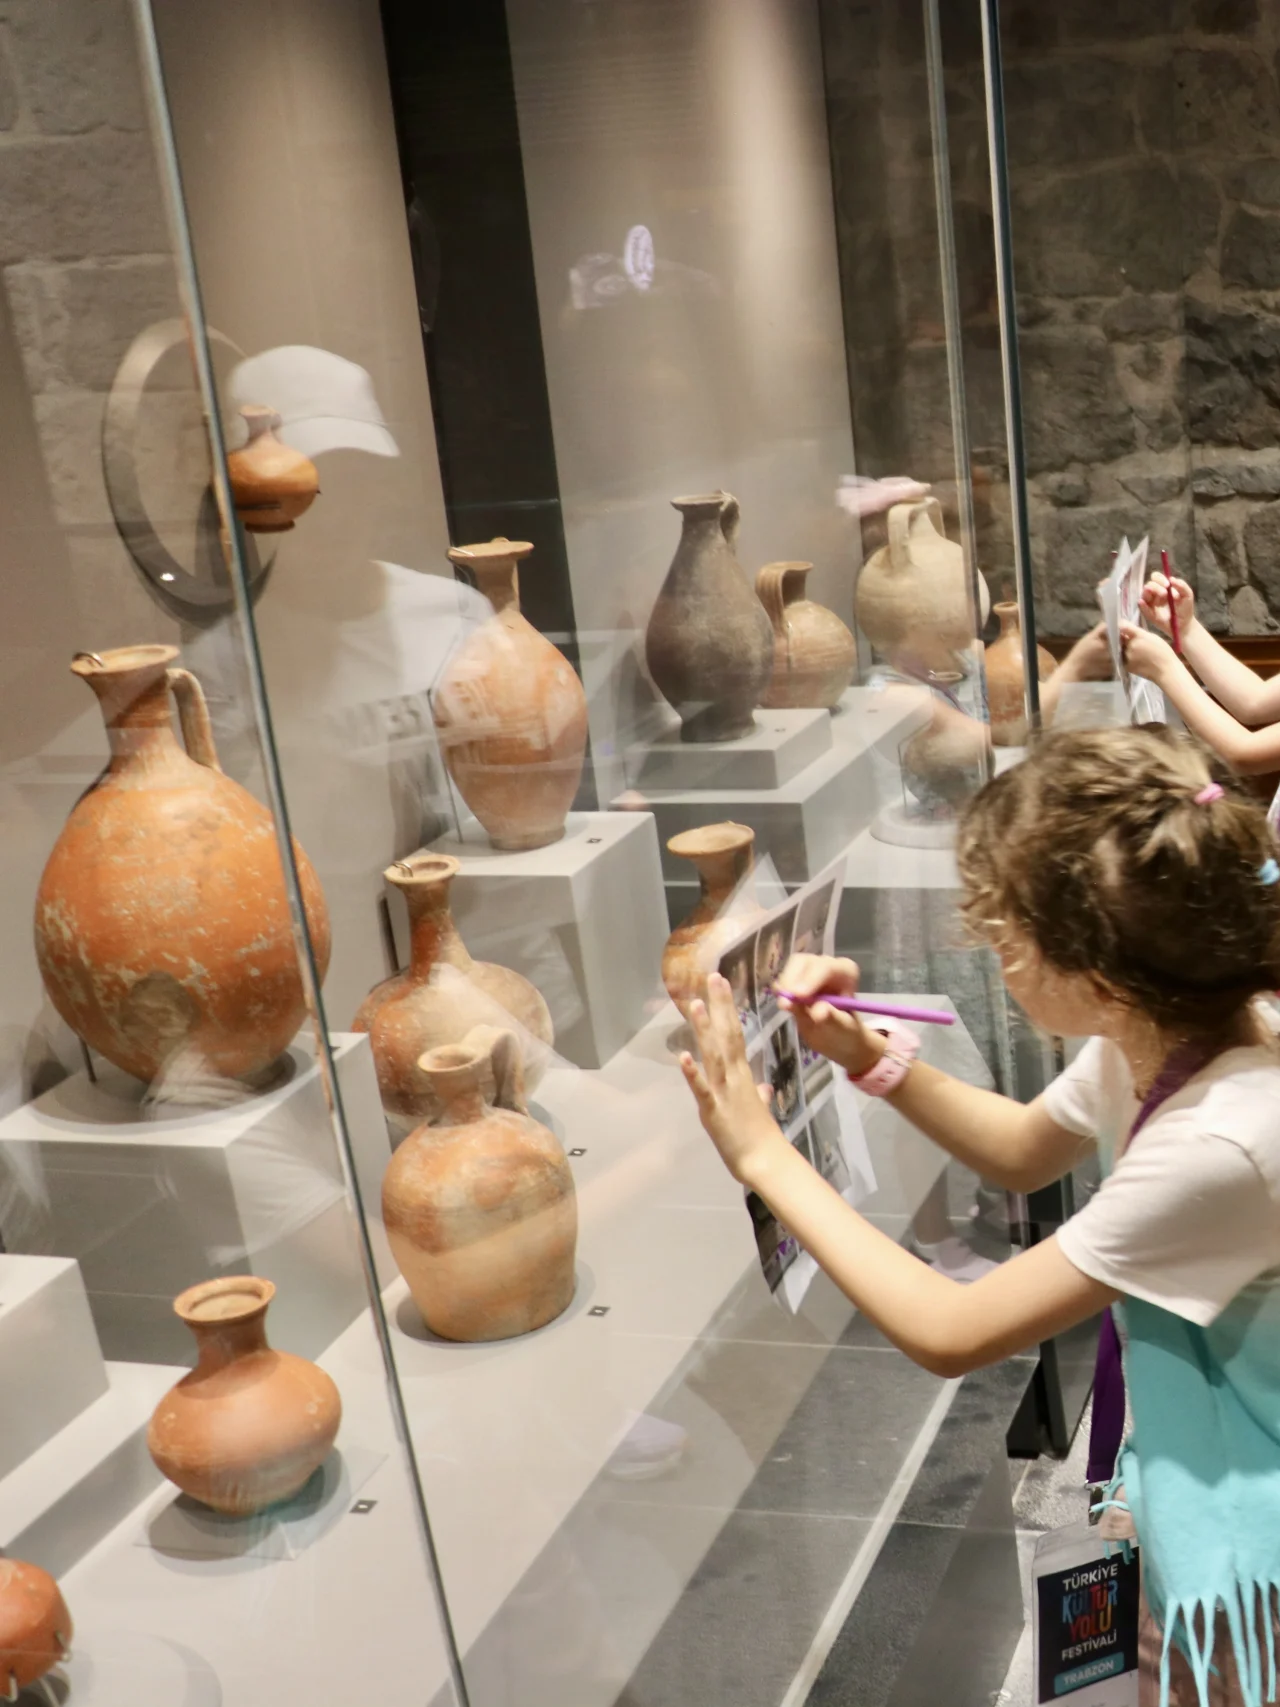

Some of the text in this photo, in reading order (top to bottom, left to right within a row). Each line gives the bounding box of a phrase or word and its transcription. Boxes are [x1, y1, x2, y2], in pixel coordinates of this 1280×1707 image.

[1062, 1563, 1119, 1592] TÜRKİYE
[1068, 1604, 1113, 1642] YOLU
[1061, 1628, 1118, 1661] FESTİVALİ
[1063, 1659, 1116, 1686] TRABZON
